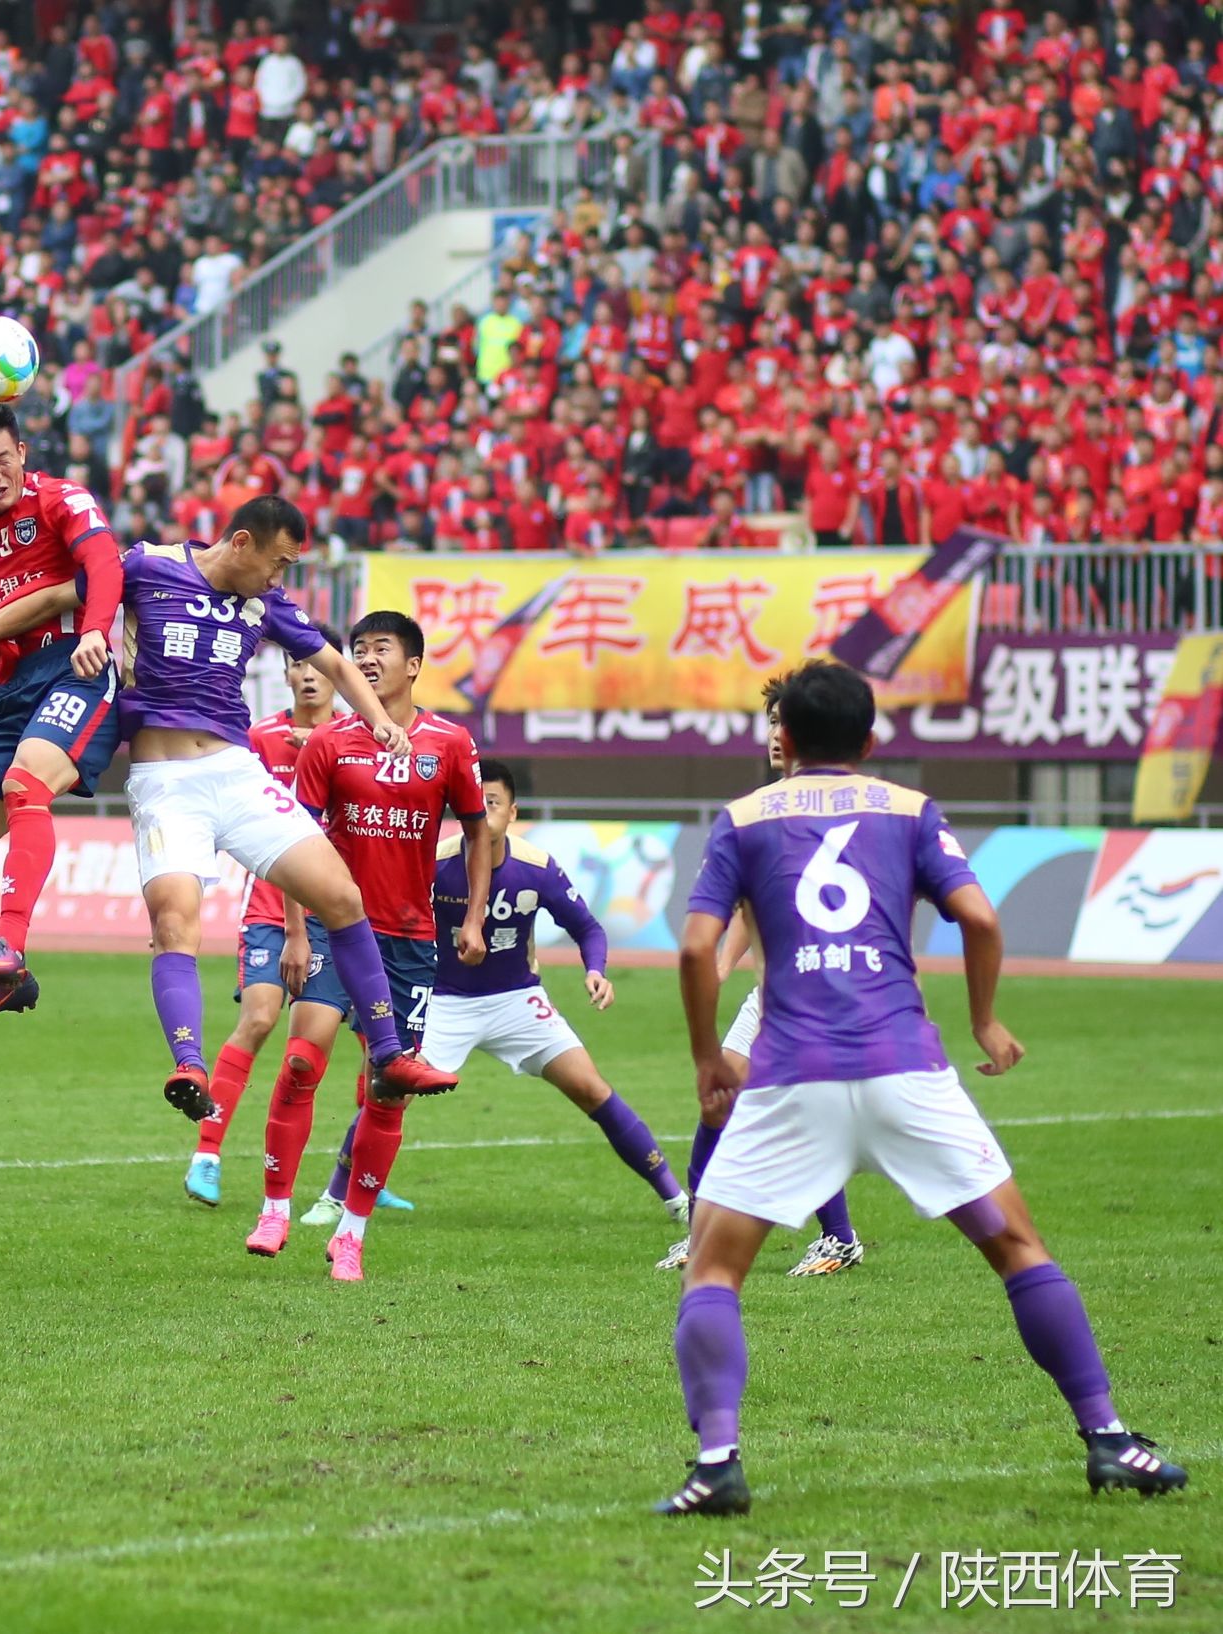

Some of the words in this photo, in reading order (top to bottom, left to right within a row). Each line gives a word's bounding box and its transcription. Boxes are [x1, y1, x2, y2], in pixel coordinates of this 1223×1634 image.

[185, 594, 238, 623] 33
[162, 621, 243, 668] 雷曼
[40, 691, 88, 726] 39
[36, 716, 75, 734] KELME
[337, 757, 375, 765] KELME
[375, 751, 411, 783] 28
[760, 784, 892, 816] 深圳雷曼
[343, 803, 430, 830] 秦农银行
[398, 830, 424, 840] BANK
[794, 820, 871, 933] 6
[484, 888, 513, 921] 6
[795, 943, 884, 974] 杨剑飞
